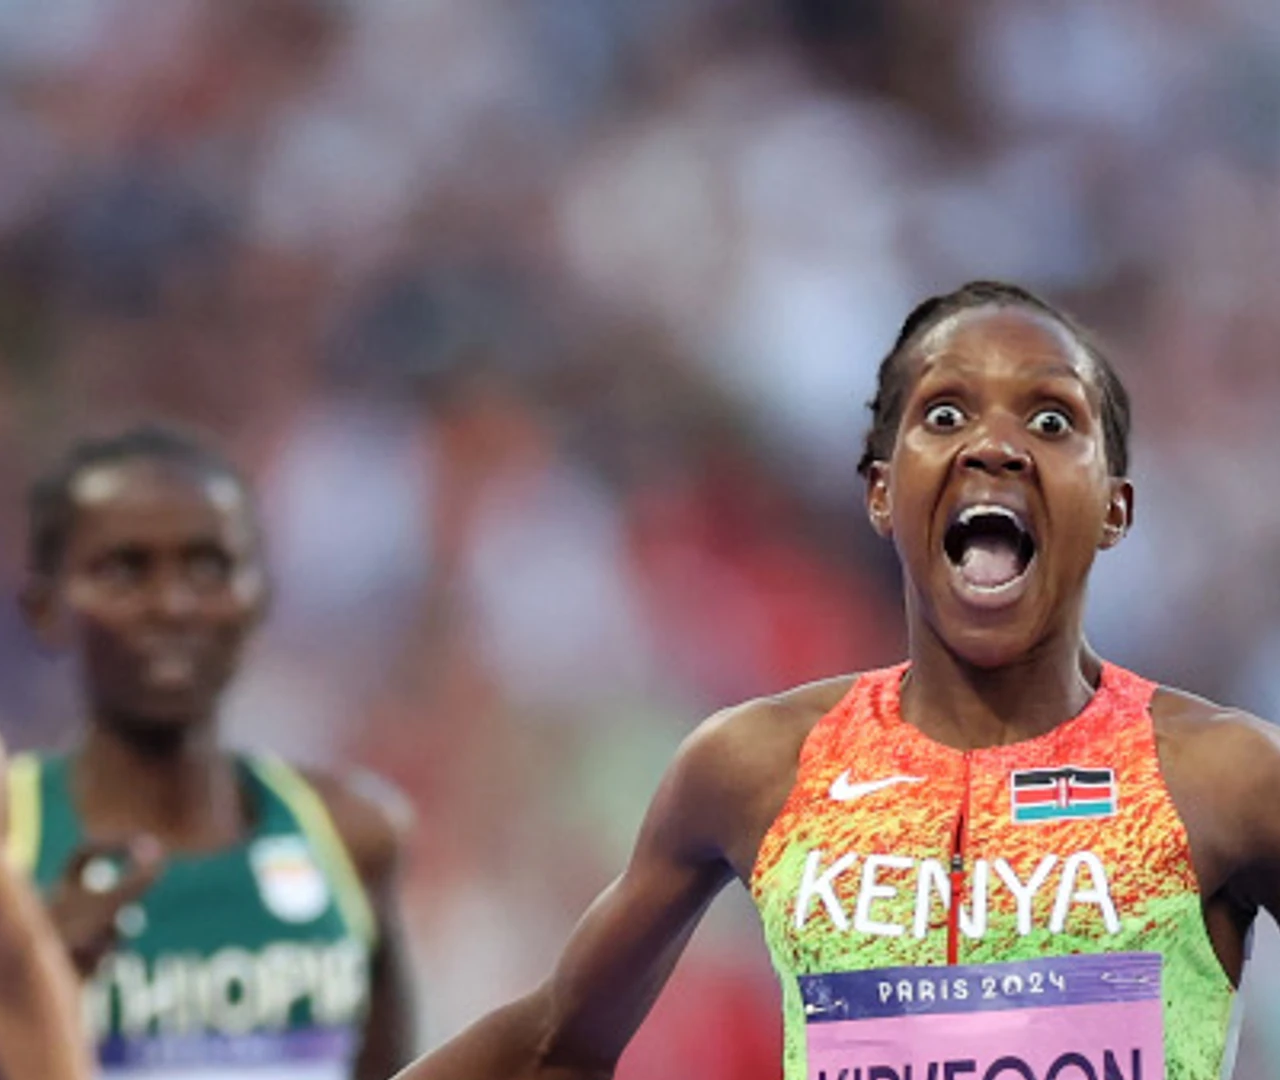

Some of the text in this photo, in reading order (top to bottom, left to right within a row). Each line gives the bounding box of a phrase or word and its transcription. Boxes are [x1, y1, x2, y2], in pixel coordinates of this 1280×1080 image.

[794, 850, 1122, 938] KENYA
[83, 938, 372, 1036] THIOPI
[878, 970, 1066, 1003] PARIS 2024
